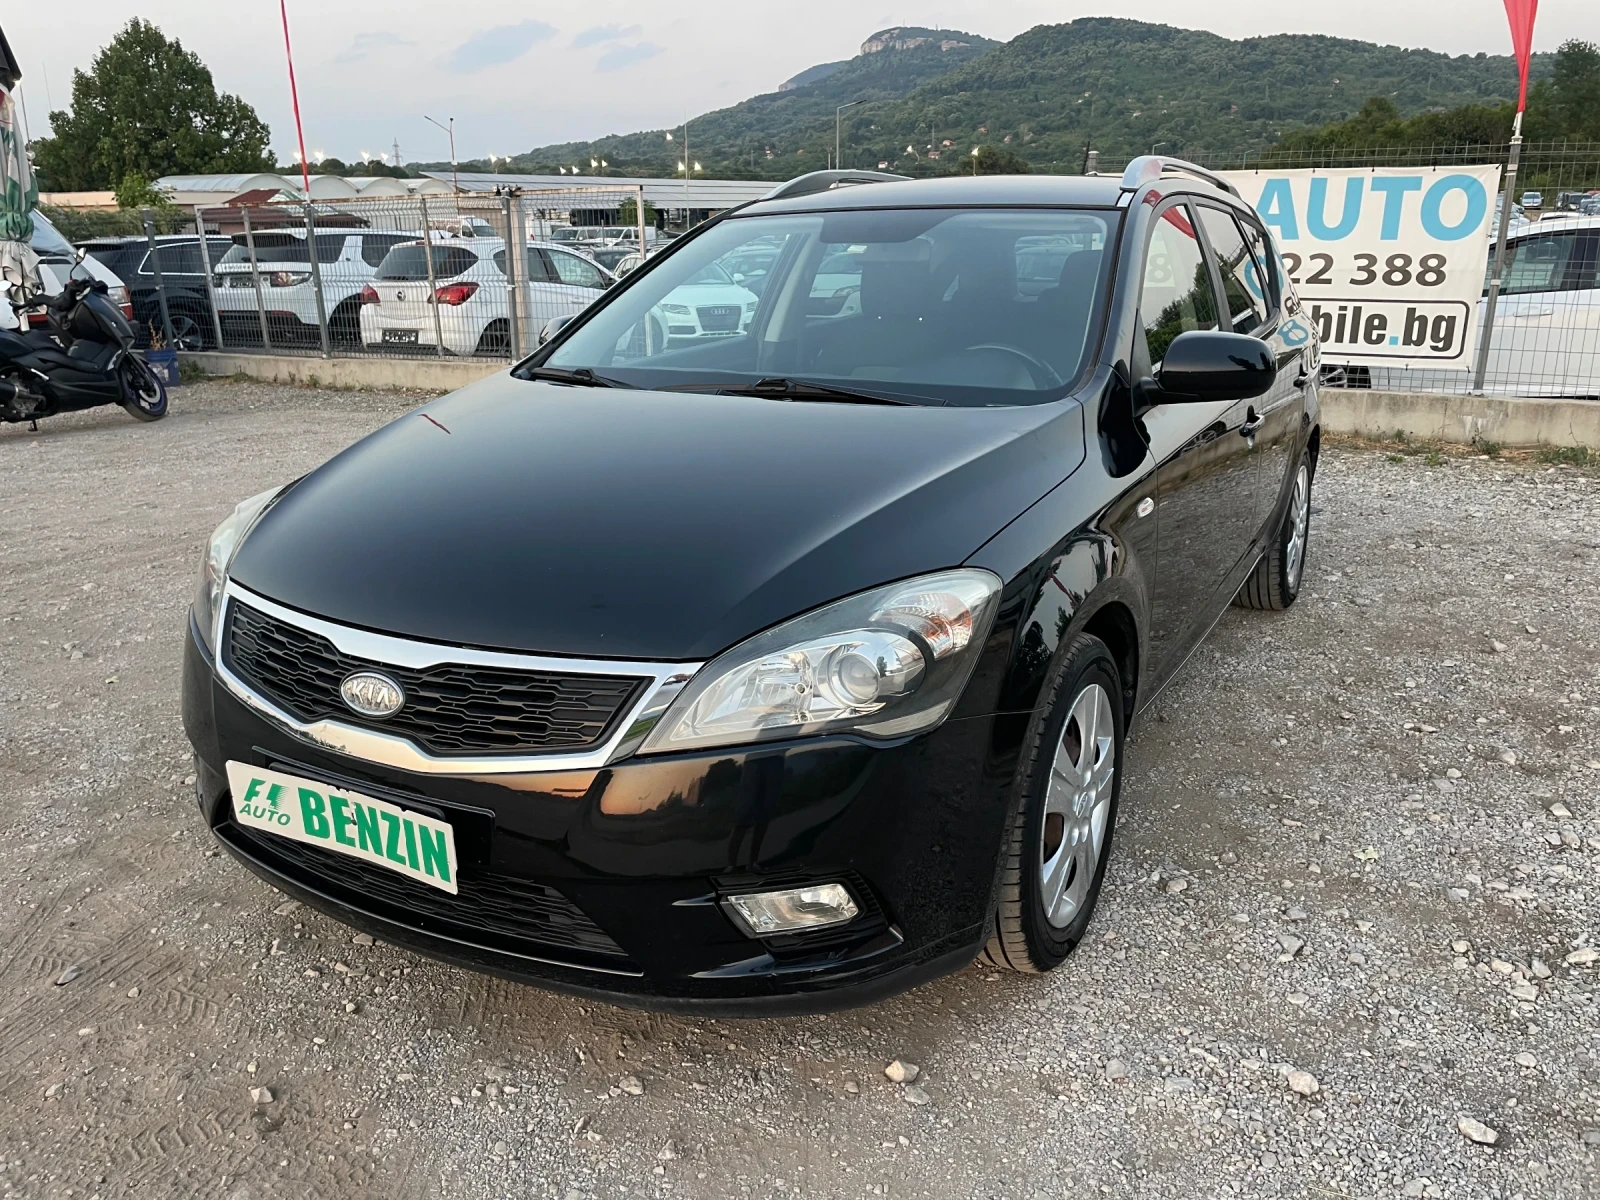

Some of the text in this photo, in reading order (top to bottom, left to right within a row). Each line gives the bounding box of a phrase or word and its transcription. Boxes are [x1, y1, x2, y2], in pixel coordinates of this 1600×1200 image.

[1255, 174, 1488, 242] AUTO
[1349, 252, 1448, 287] 388
[351, 680, 391, 704] KIA
[239, 802, 291, 827] AUTO
[297, 786, 452, 884] BENZIN
